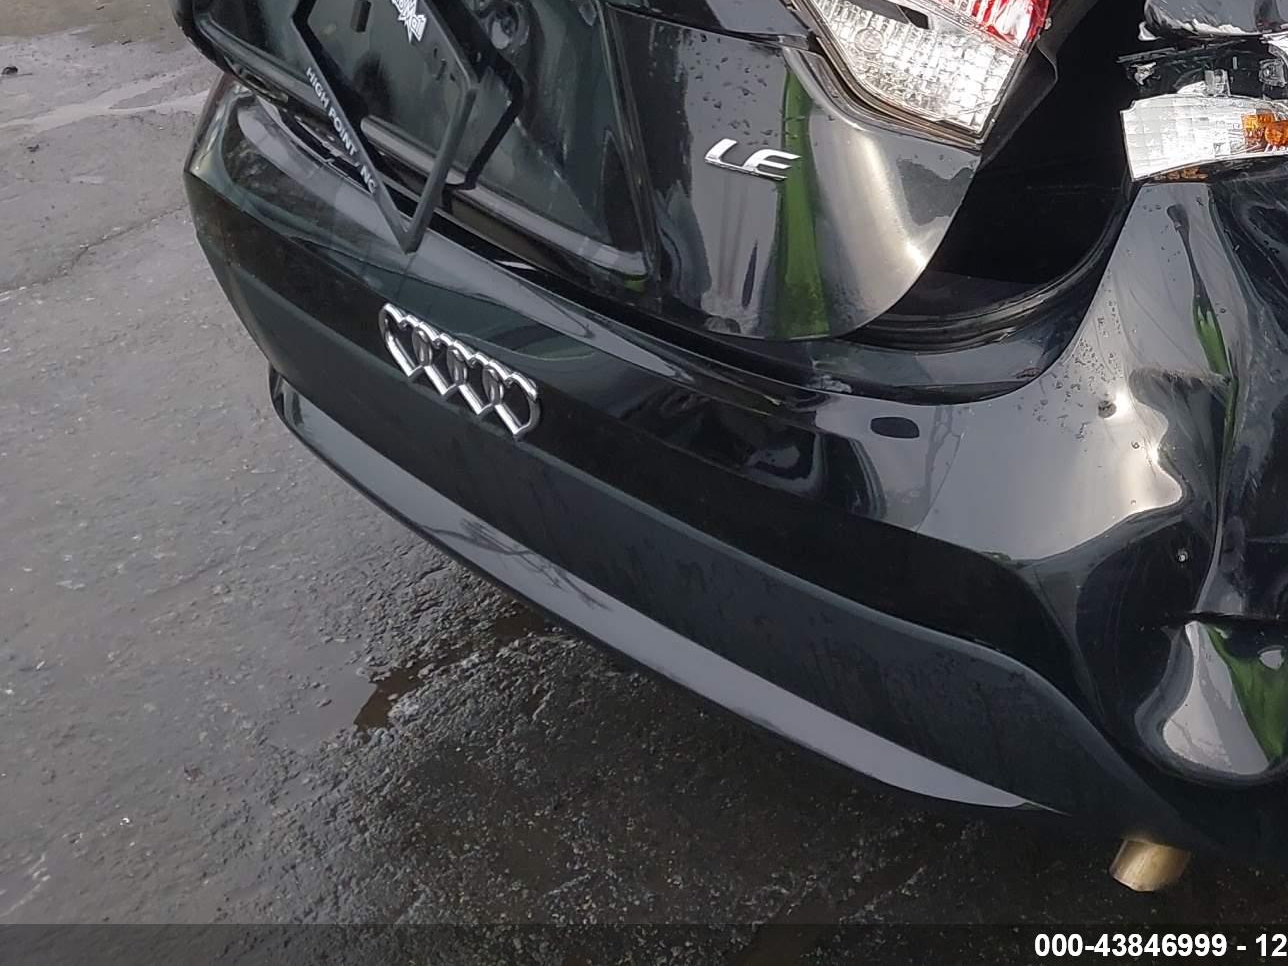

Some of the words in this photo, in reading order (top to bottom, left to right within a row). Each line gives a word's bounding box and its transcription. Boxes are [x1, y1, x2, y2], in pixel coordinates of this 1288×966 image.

[306, 67, 330, 108] HIGH
[360, 165, 377, 195] NC
[704, 138, 802, 181] LE
